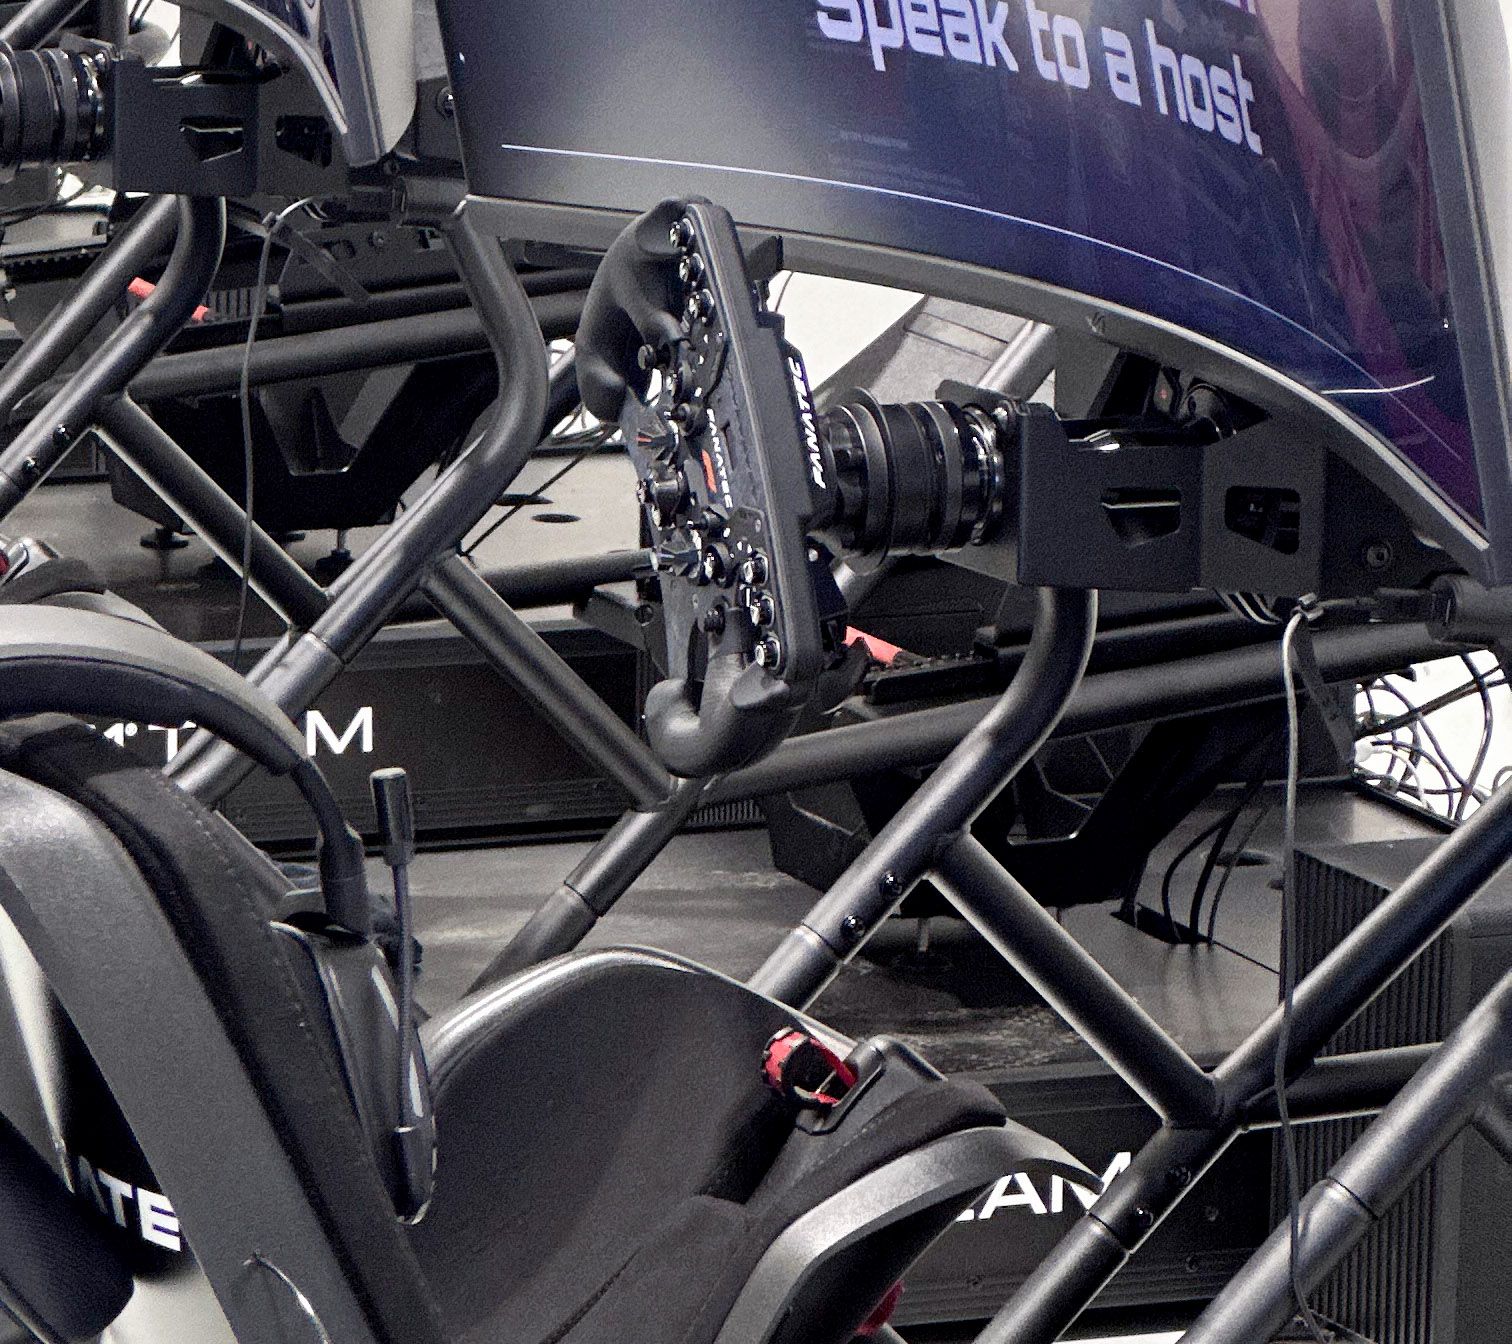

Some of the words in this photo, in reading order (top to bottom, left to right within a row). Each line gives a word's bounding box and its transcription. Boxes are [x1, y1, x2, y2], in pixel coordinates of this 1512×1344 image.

[1100, 25, 1141, 106] a
[1144, 18, 1263, 155] host
[787, 356, 827, 489] FANATEC
